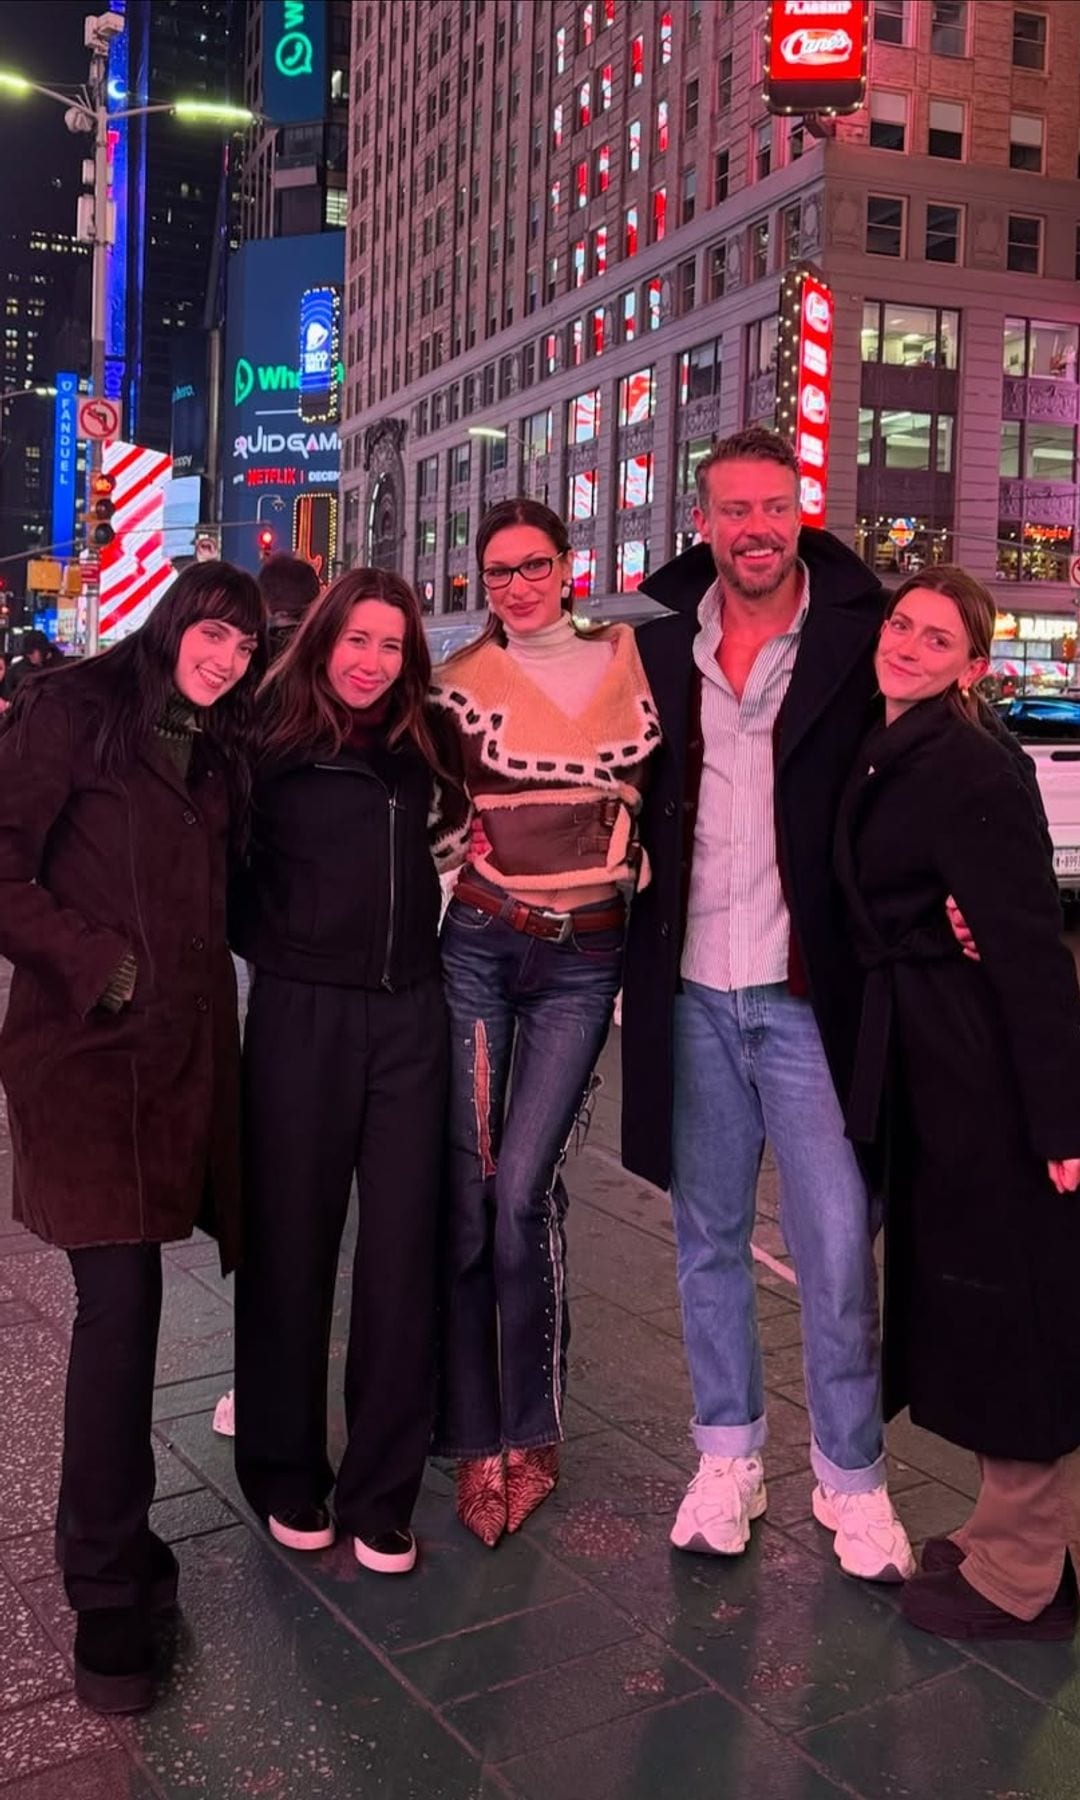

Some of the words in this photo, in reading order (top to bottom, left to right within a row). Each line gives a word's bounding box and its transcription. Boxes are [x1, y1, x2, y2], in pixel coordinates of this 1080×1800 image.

[60, 398, 71, 485] FANDUEL
[233, 425, 286, 459] QUID
[247, 467, 296, 488] NETFLIX
